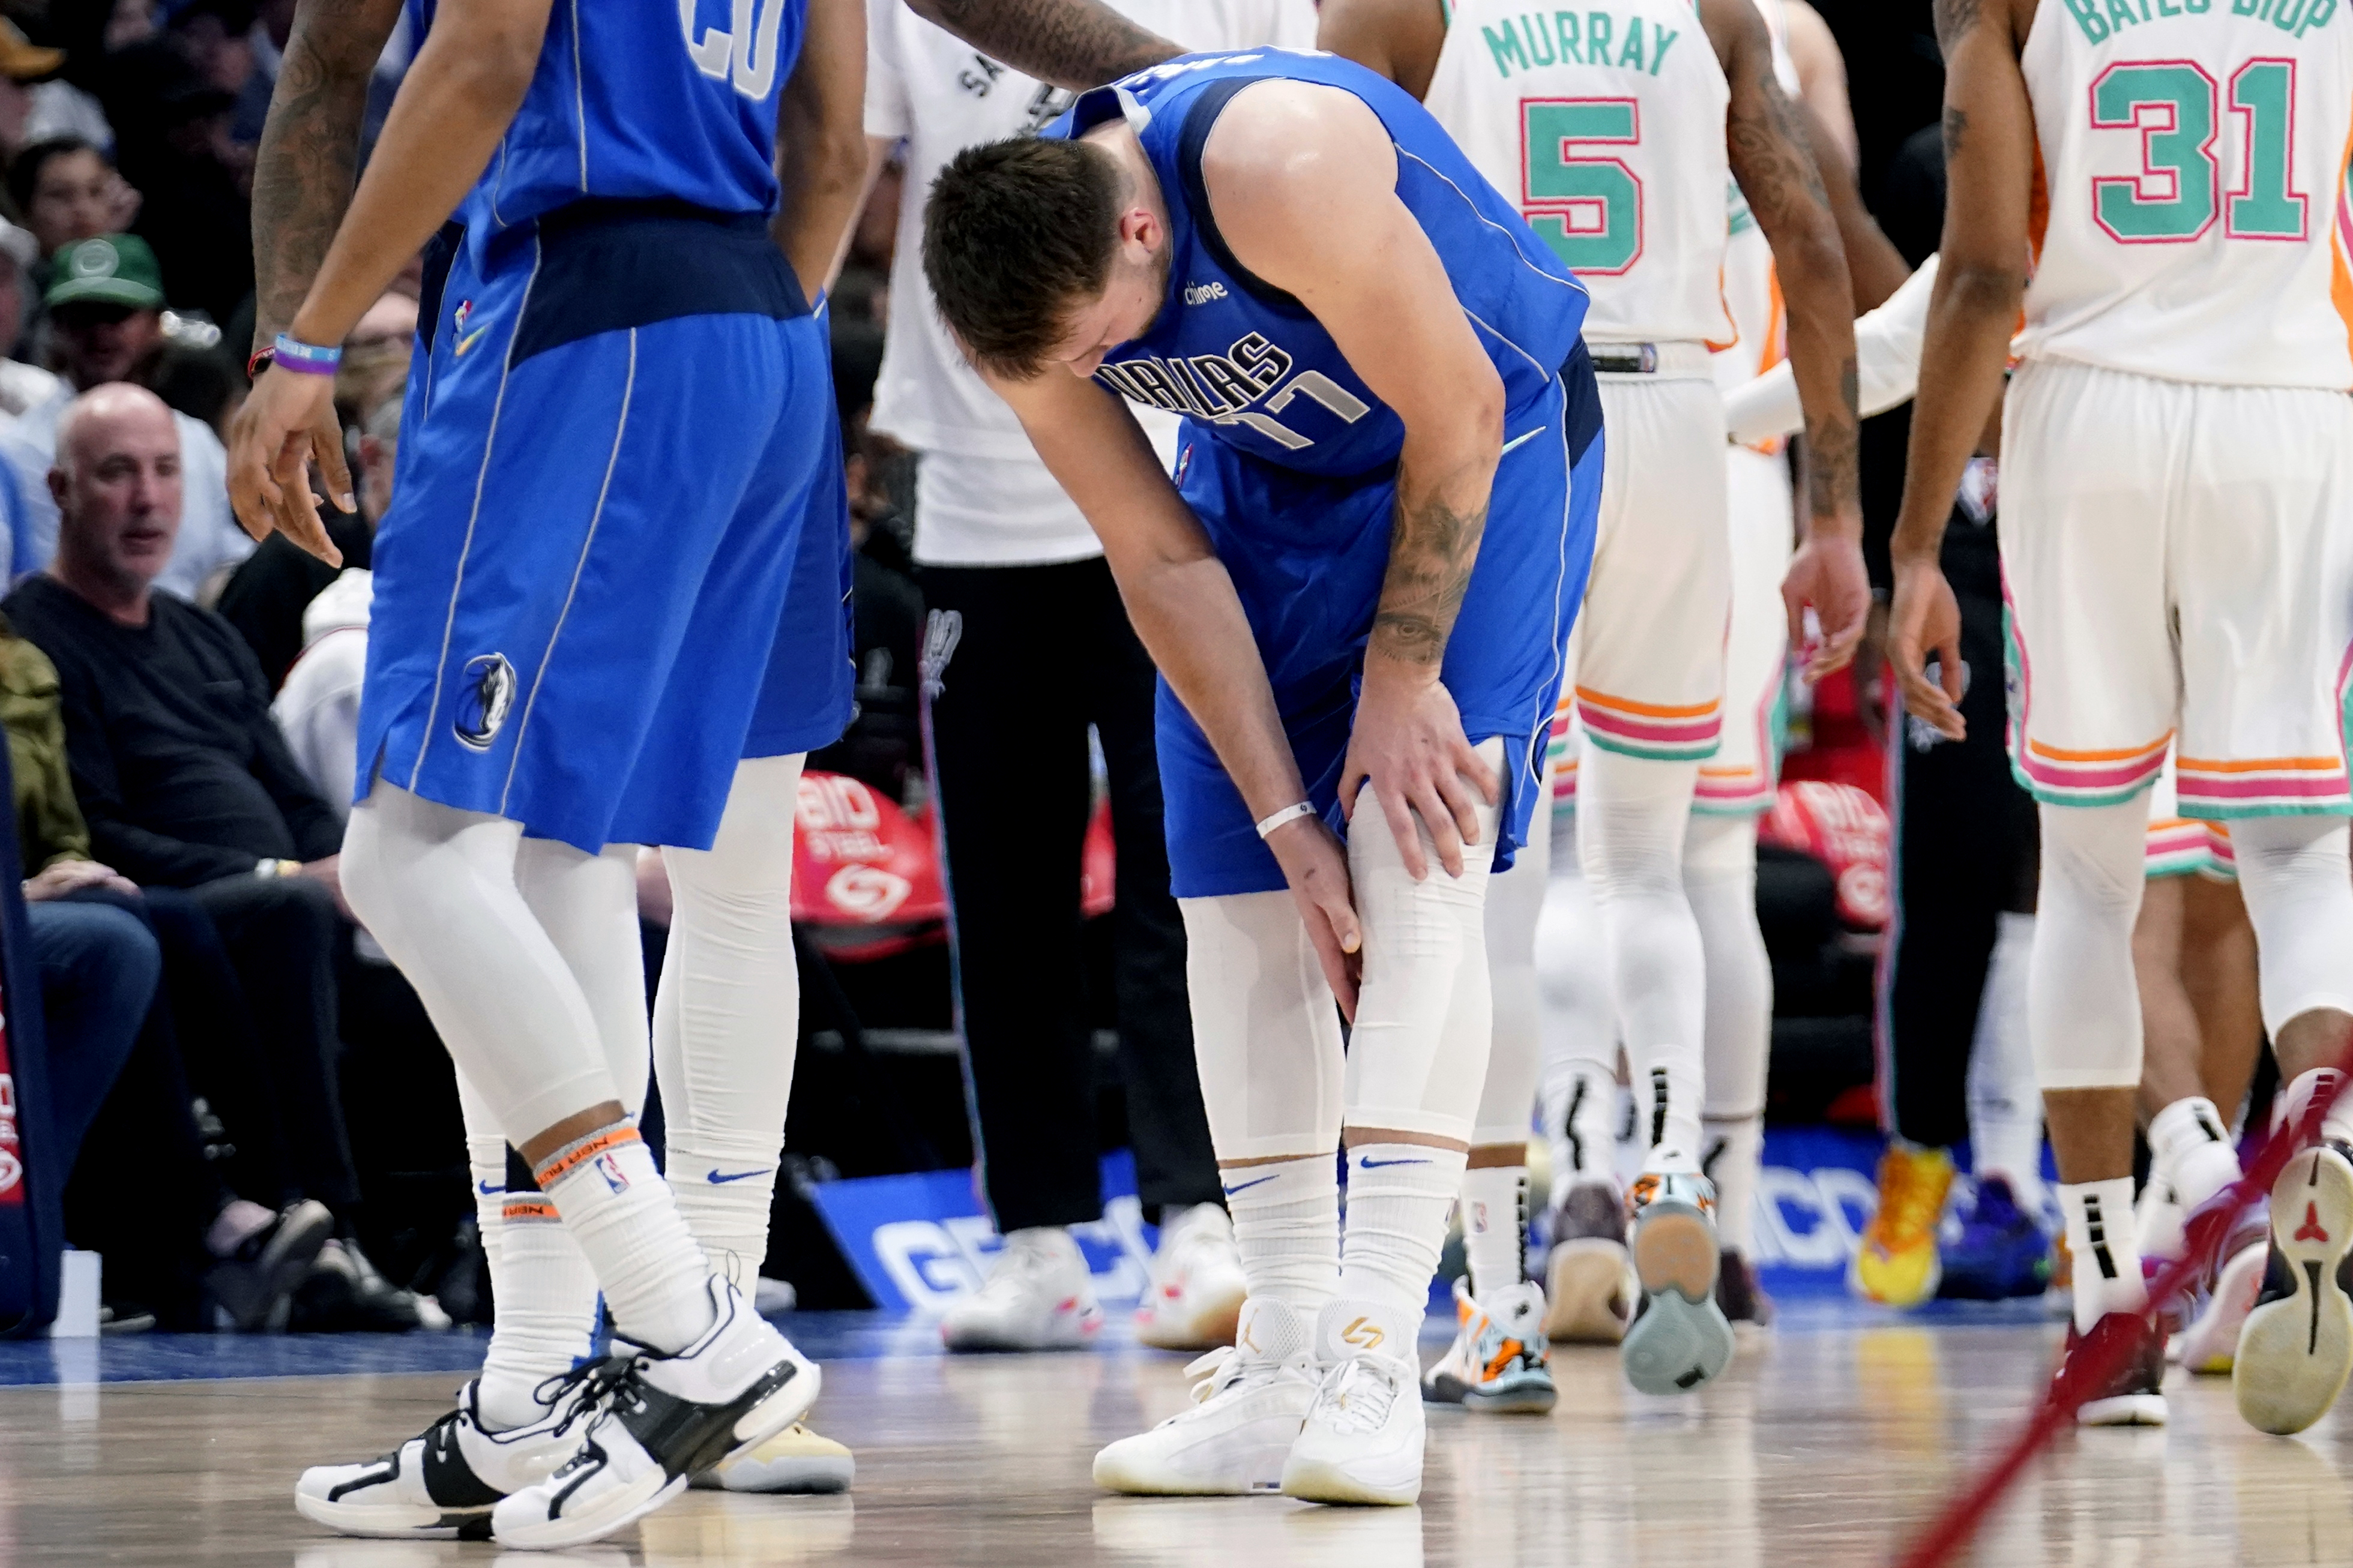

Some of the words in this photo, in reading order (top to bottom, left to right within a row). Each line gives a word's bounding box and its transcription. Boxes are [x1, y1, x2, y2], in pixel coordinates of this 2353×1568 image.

[959, 53, 1005, 98] SA
[1481, 10, 1680, 79] MURRAY
[2089, 57, 2309, 244] 31
[1520, 97, 1643, 276] 5
[1184, 280, 1229, 306] chime
